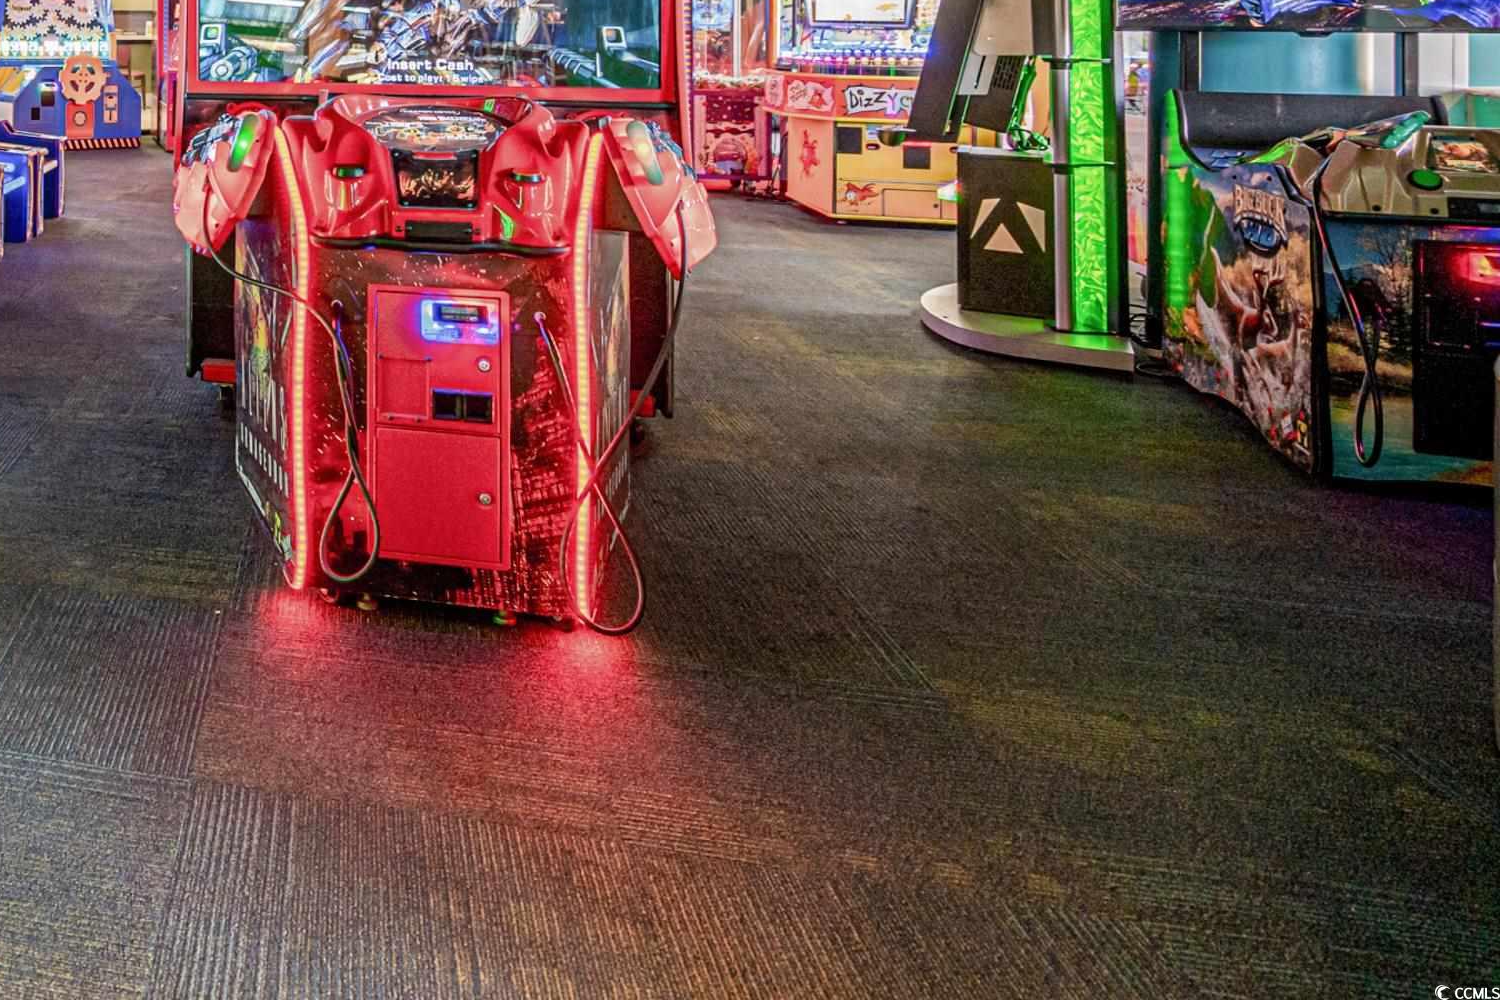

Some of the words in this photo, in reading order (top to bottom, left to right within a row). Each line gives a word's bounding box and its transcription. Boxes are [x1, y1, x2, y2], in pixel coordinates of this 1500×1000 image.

[387, 59, 433, 71] Insert
[435, 59, 474, 71] Cash
[404, 73, 416, 83] to
